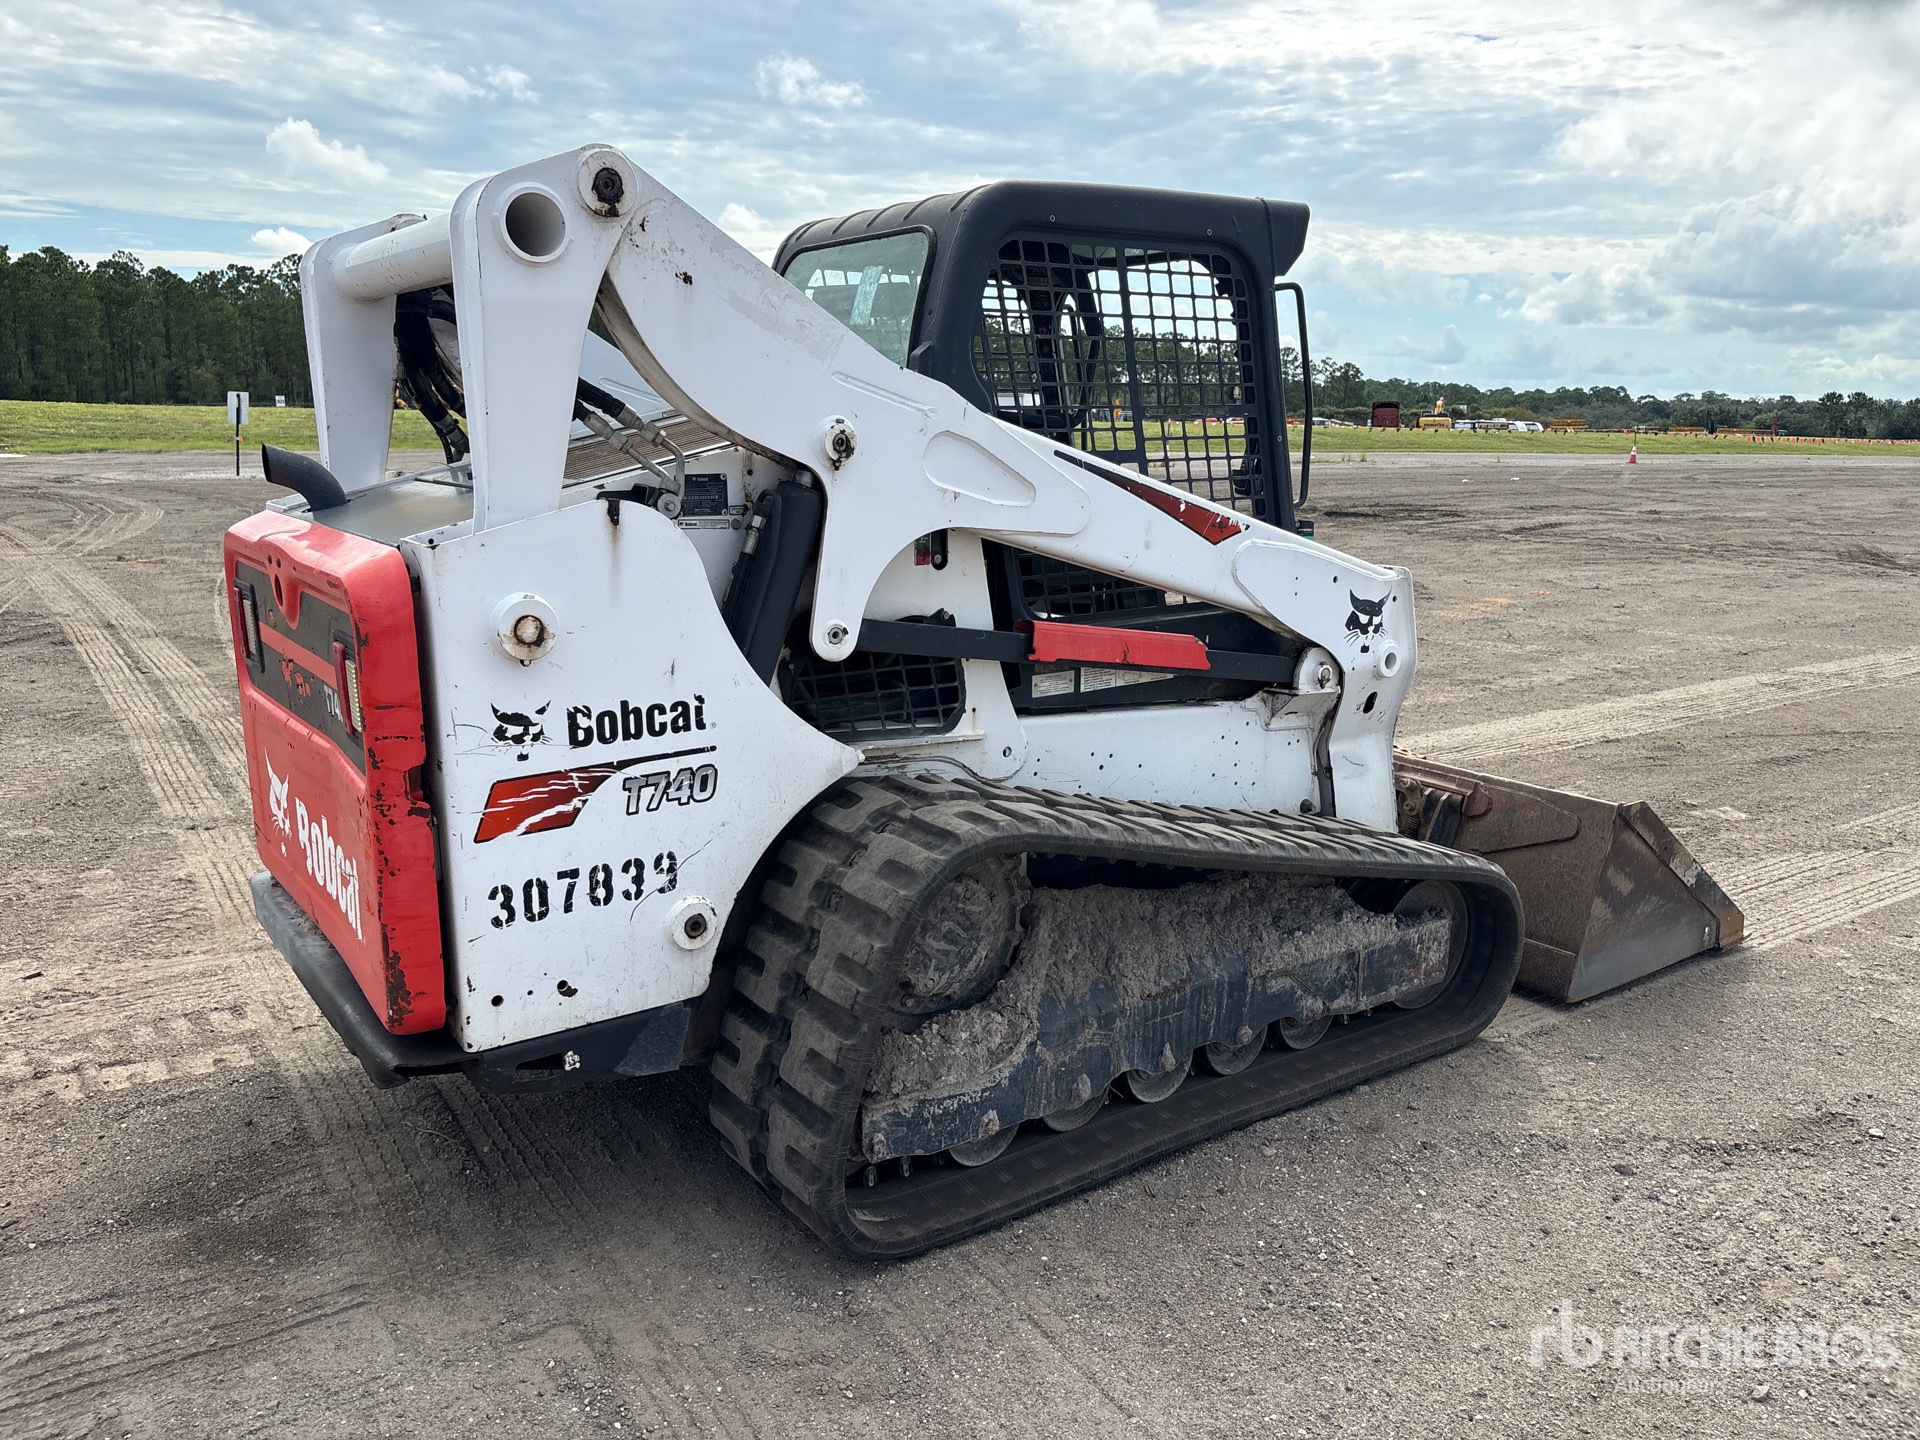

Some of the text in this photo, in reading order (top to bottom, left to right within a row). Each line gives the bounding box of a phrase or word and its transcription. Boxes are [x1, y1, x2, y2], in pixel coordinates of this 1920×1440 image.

[323, 684, 343, 723] T74
[566, 694, 707, 749] Bobcat
[622, 763, 718, 816] T740
[294, 797, 363, 943] Bobcat
[487, 850, 678, 930] 307839
